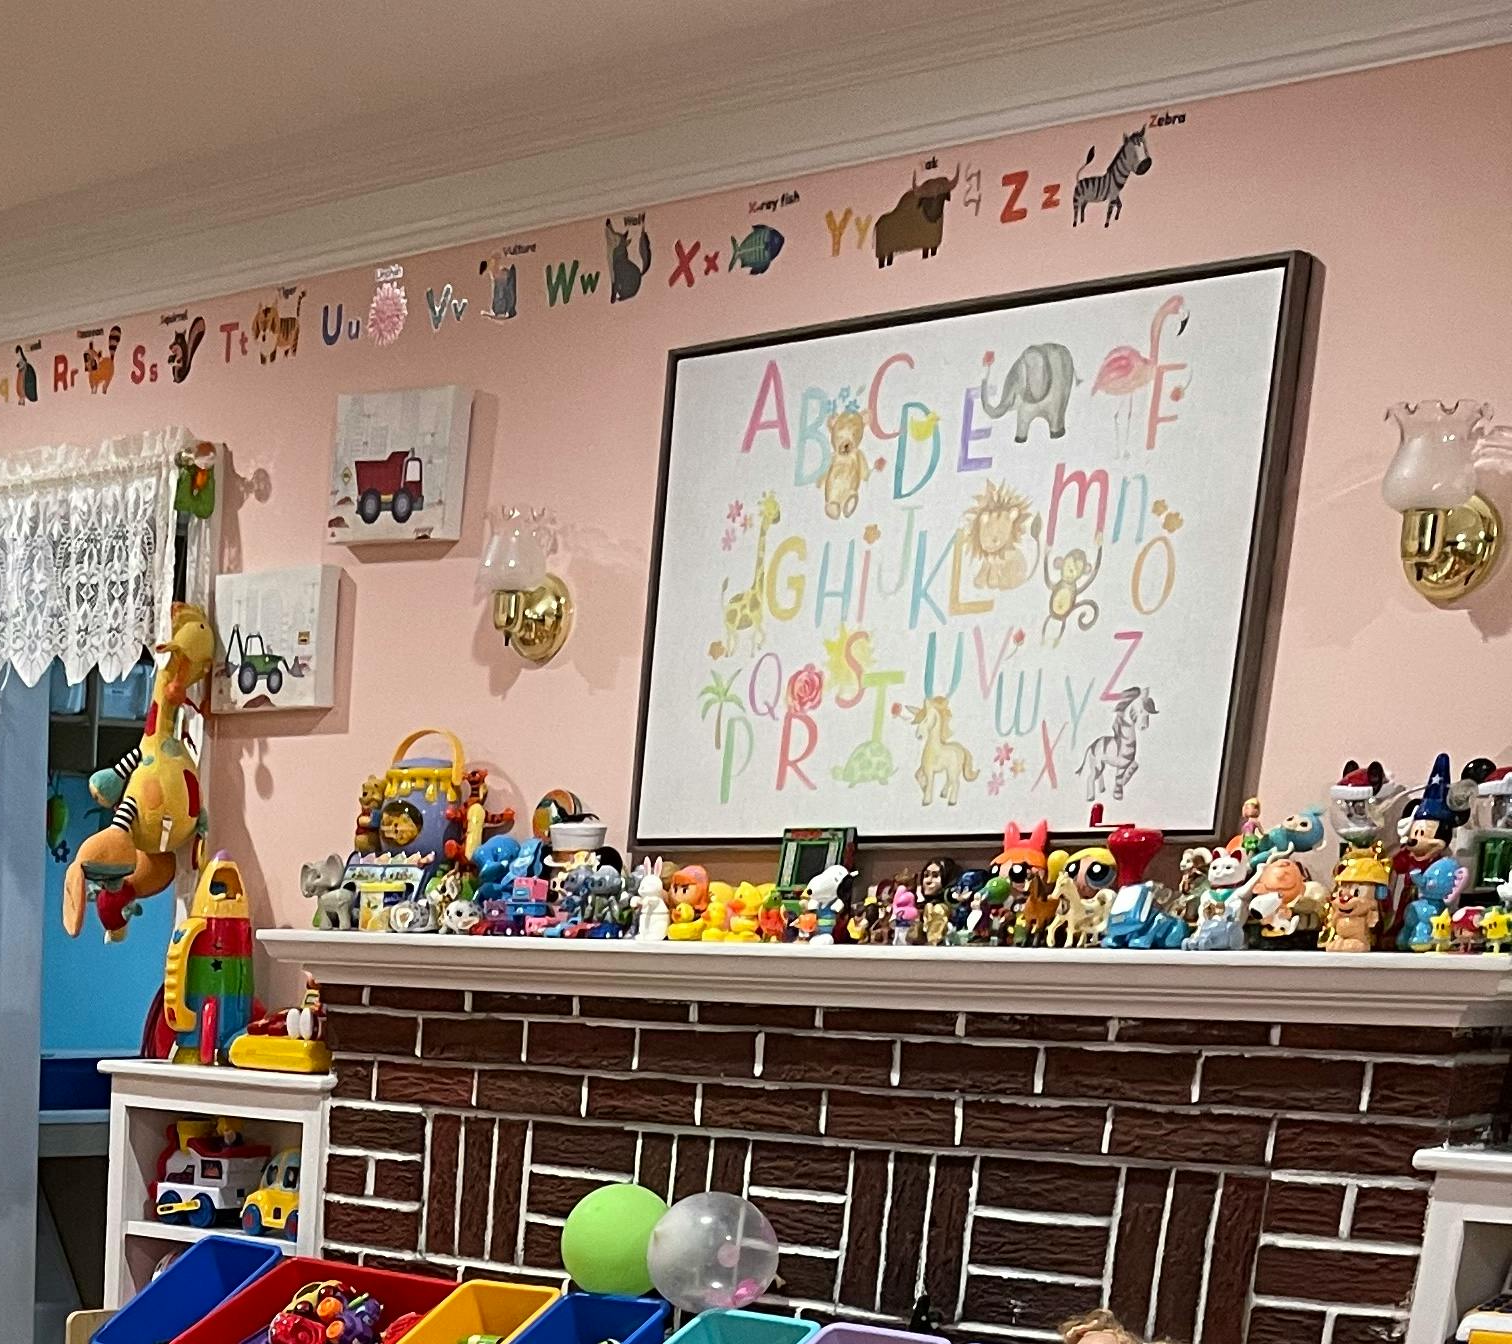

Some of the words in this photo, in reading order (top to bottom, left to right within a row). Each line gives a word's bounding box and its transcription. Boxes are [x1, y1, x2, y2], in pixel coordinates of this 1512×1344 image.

[1149, 112, 1186, 130] Zebra
[920, 156, 938, 171] ak
[624, 213, 646, 228] Wolf
[748, 198, 779, 215] X-ray
[780, 189, 800, 207] fish
[54, 354, 78, 392] Rr
[131, 345, 158, 385] Ss
[220, 322, 248, 363] Tt
[322, 304, 360, 345] Uu
[426, 284, 469, 330] Vv
[545, 259, 600, 309] Ww
[668, 240, 720, 287] Xx
[825, 207, 873, 257] Yy
[741, 360, 790, 454] A
[794, 386, 834, 487] B
[868, 353, 915, 440] C
[893, 402, 942, 500] D
[956, 386, 995, 472] E
[1145, 363, 1189, 451] F
[766, 536, 808, 621] G
[816, 538, 856, 627] H
[908, 527, 958, 630] K
[948, 529, 995, 616] L
[1131, 536, 1176, 615] O
[720, 715, 755, 804] P
[748, 653, 782, 721] Q
[775, 712, 818, 792] R
[834, 631, 871, 710] S
[862, 671, 906, 742] T
[924, 631, 962, 699] U
[975, 626, 1010, 699] V
[1031, 720, 1068, 792] X
[1064, 675, 1094, 750] Y
[1099, 630, 1143, 702] Z
